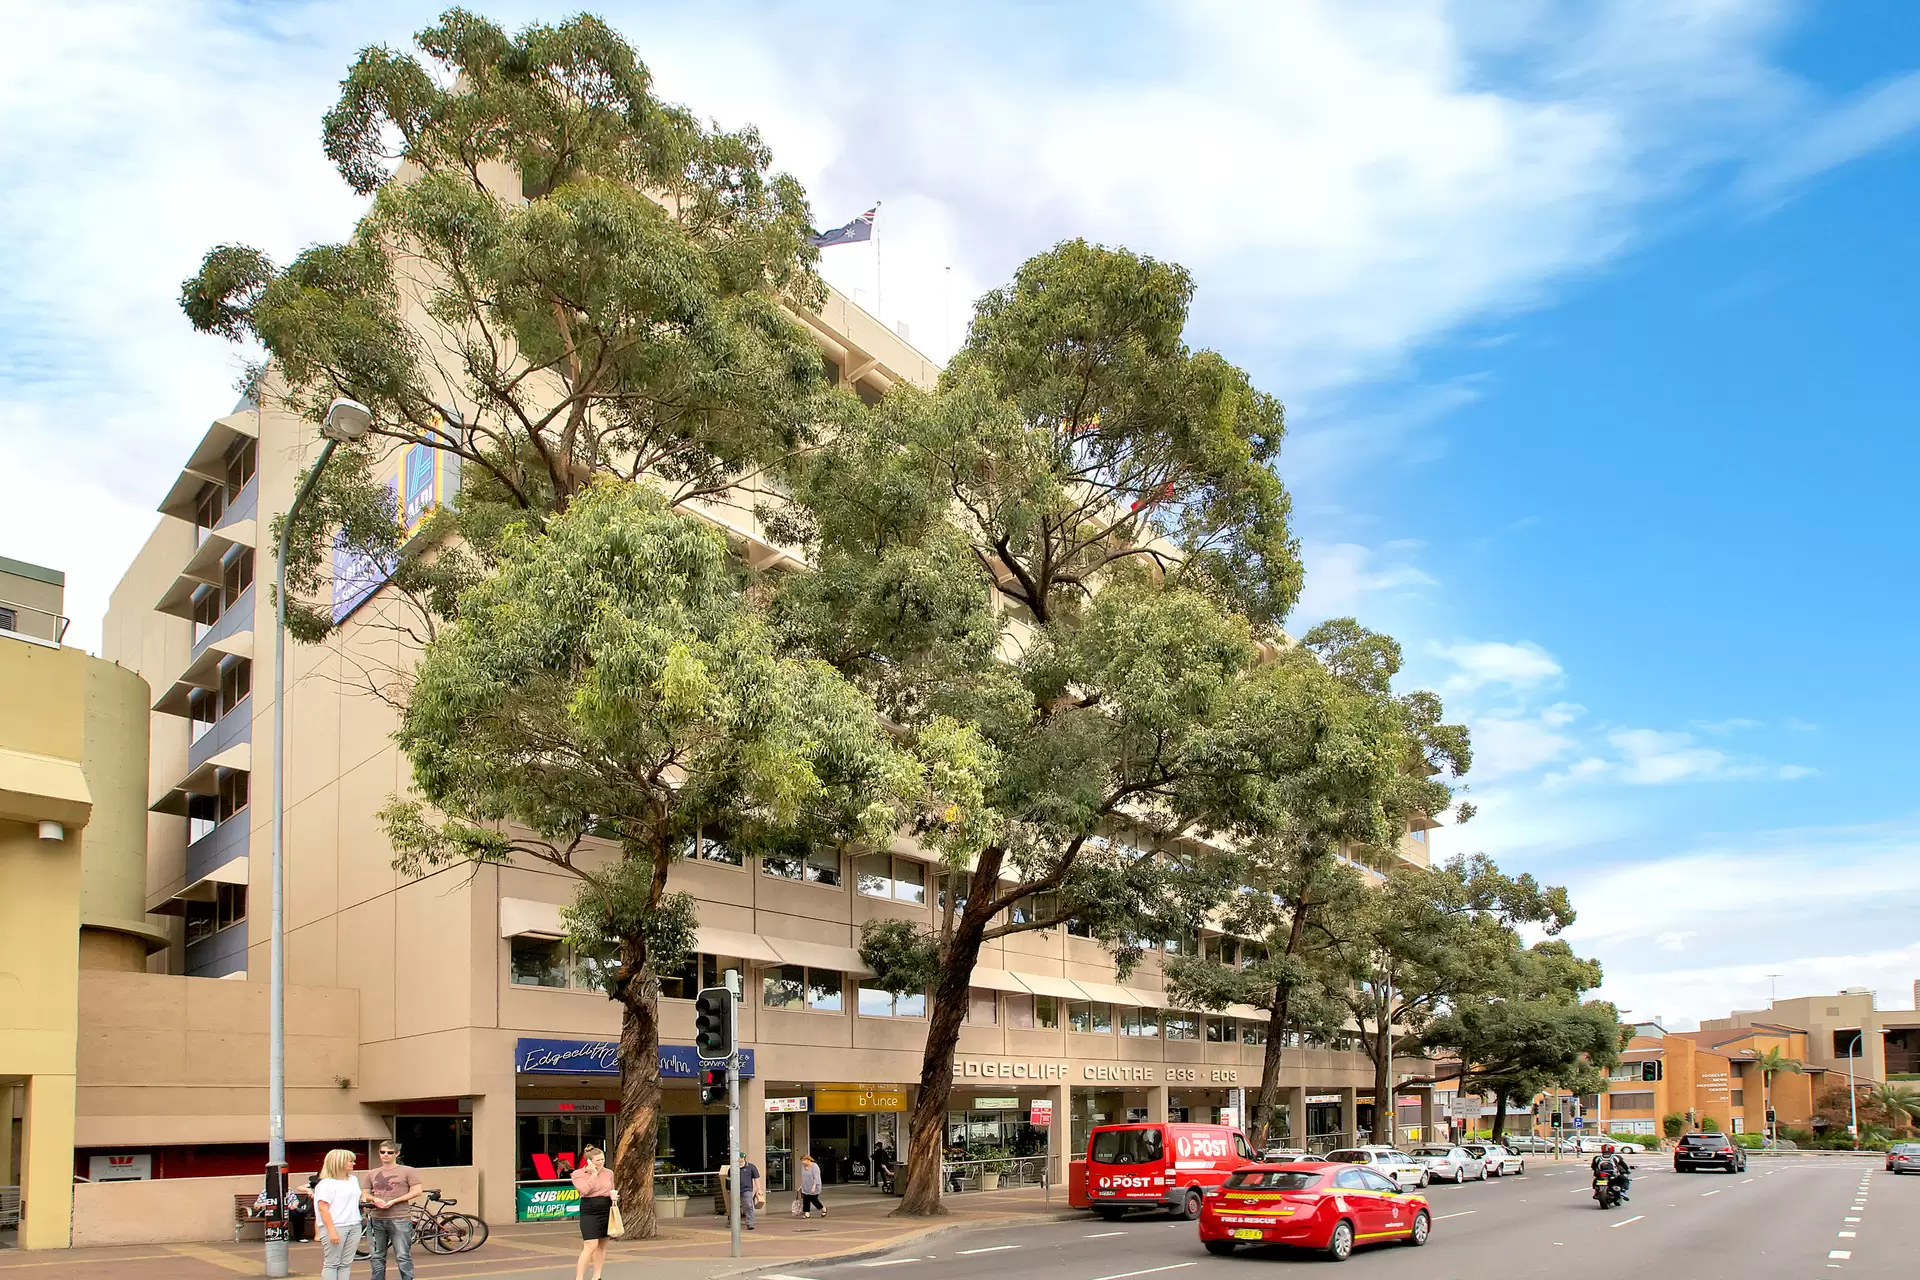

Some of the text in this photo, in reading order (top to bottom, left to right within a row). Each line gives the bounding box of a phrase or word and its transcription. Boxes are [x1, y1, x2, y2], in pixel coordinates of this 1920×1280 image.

[408, 484, 432, 516] ALDI
[524, 1042, 610, 1071] Edgecliff
[952, 1060, 1238, 1082] EDGECLIFF CENTRE 233 203
[859, 1091, 898, 1106] bounce
[560, 1103, 600, 1113] Westpac
[1192, 1140, 1227, 1156] POST
[1113, 1177, 1151, 1188] POST
[527, 1205, 544, 1214] NOW
[546, 1203, 566, 1213] OPEN
